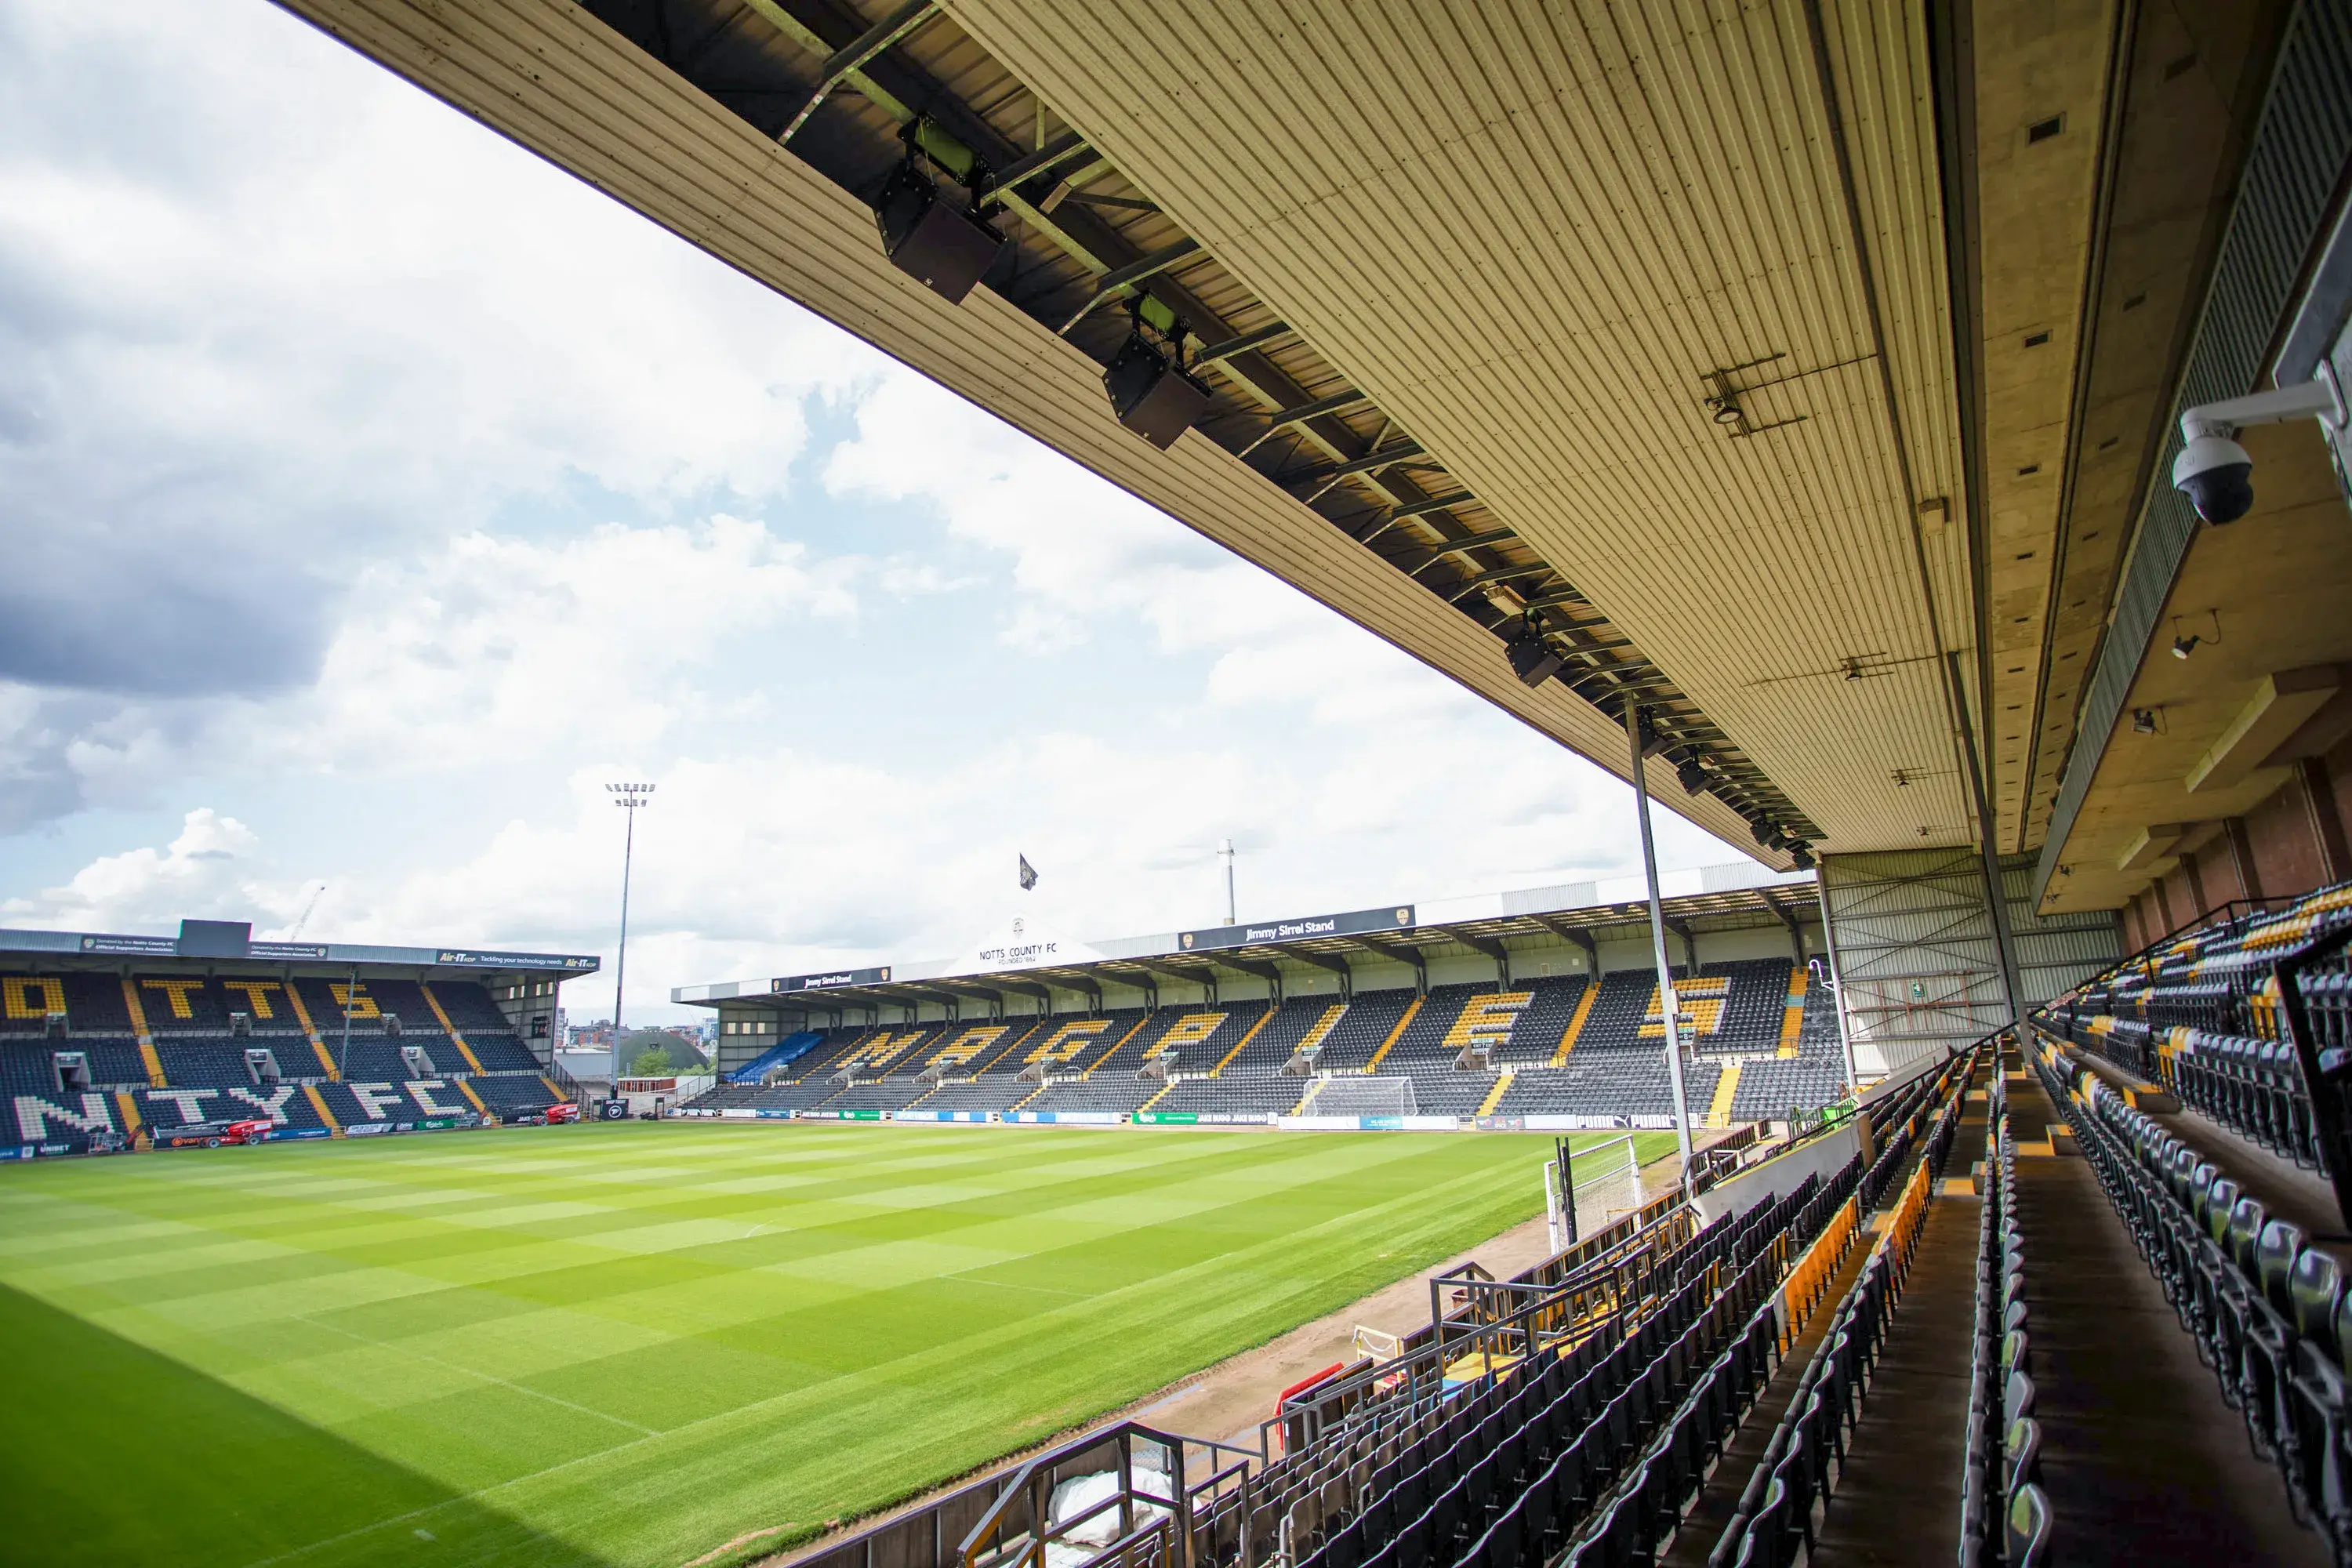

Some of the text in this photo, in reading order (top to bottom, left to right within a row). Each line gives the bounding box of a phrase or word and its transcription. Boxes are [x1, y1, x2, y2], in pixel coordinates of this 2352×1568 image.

[1247, 920, 1334, 941] Jimmy Sirrel Stand
[979, 943, 1057, 960] NOTTS COUNTY FC
[804, 974, 852, 989] Jimmy Sirrel Stand
[836, 977, 1731, 1068] MAGPIES
[349, 1080, 466, 1120] FC
[1577, 1115, 1671, 1128] PUMA PUMA
